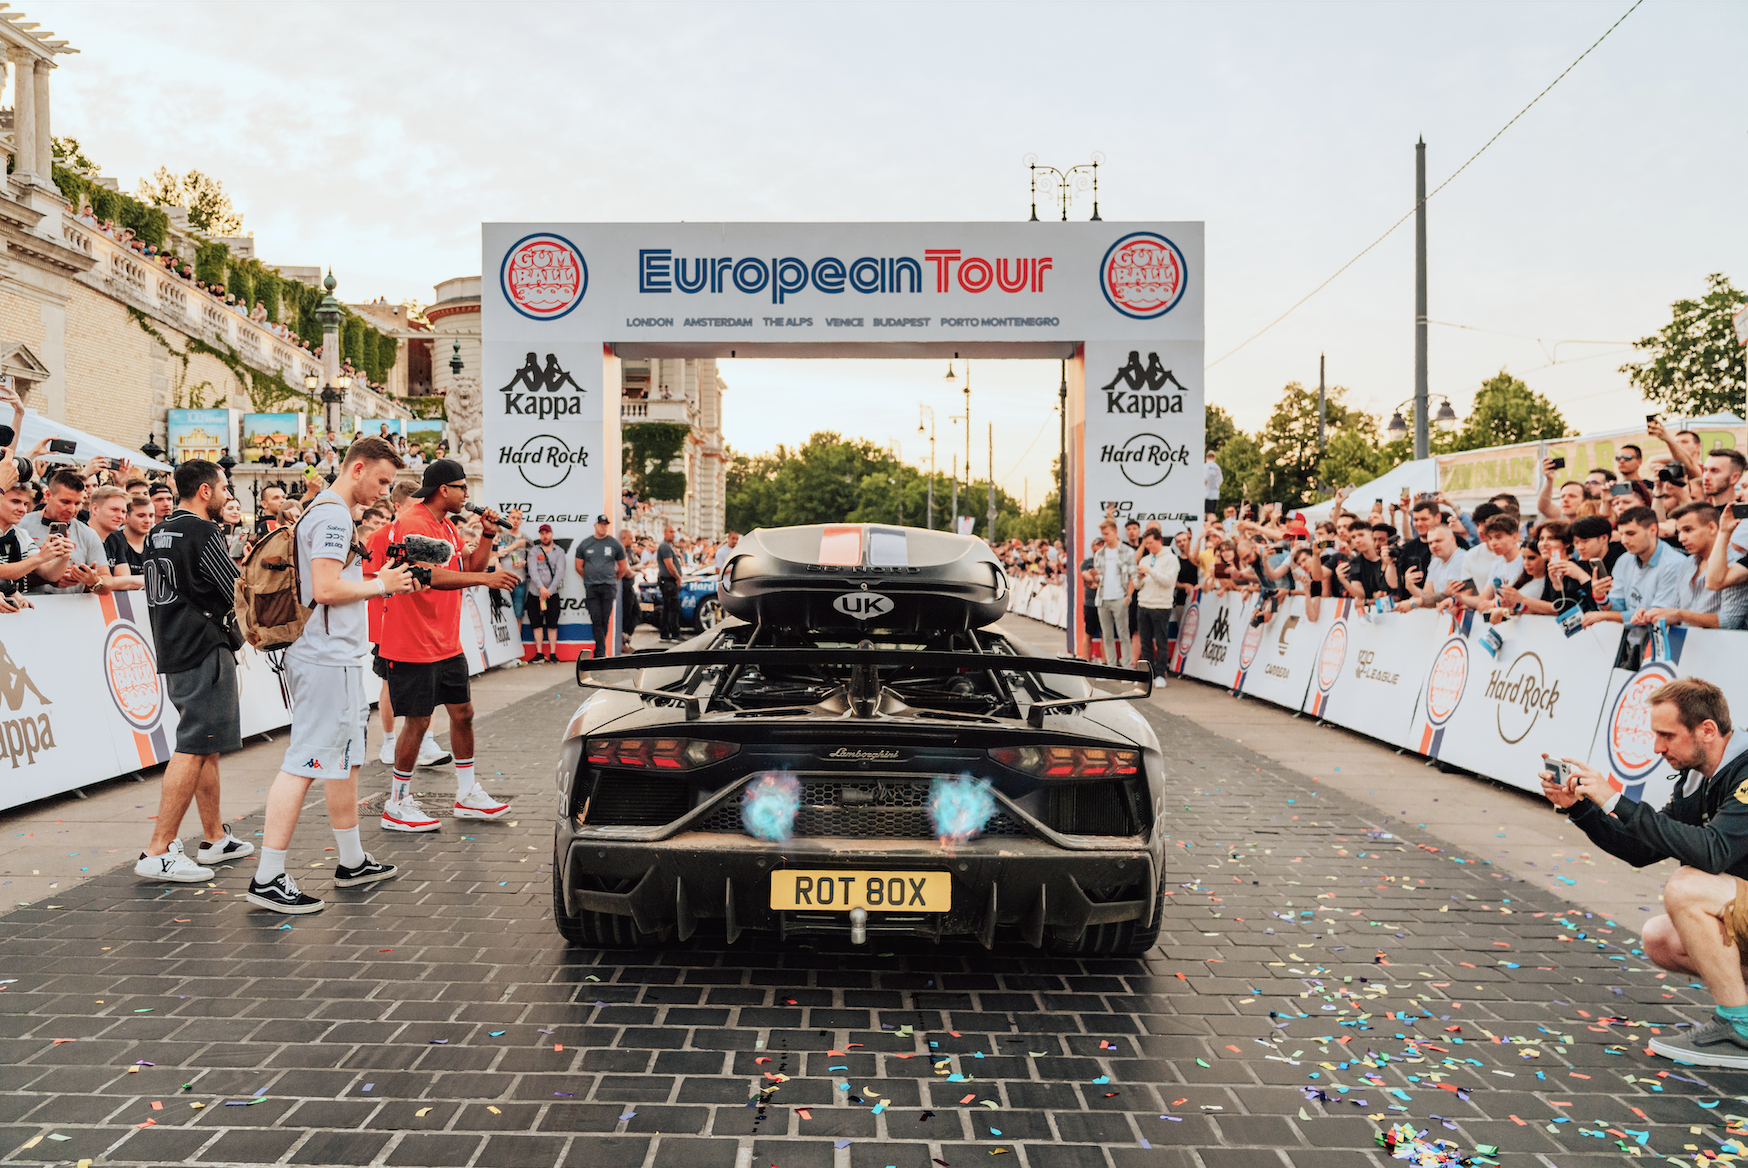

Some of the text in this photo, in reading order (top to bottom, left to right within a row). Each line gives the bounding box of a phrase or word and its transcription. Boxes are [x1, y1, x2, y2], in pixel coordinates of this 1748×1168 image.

[513, 248, 575, 269] GUM
[1113, 247, 1174, 268] GUM
[512, 267, 577, 287] BALL
[1112, 265, 1176, 286] BALL
[515, 285, 575, 304] 3000
[1114, 284, 1175, 303] 3000
[626, 317, 674, 327] LONDON
[683, 317, 753, 327] AMSTERDAM
[763, 317, 814, 327] THE ALPS
[825, 317, 865, 327] VENICE
[873, 317, 931, 327] BUDAPEST
[940, 316, 1060, 327] PORTO MONTENEGRO
[504, 392, 582, 420] Kappa
[1106, 391, 1184, 419] Kappa
[499, 446, 589, 468] Hard Rock
[1100, 444, 1190, 466] Hard Rock
[1442, 456, 1534, 491] LEMONADE
[689, 581, 715, 591] Hard
[842, 597, 885, 614] UK
[109, 643, 151, 669] GUM
[1202, 639, 1228, 667] Kappa
[111, 663, 156, 692] BALL
[1484, 669, 1560, 719] Hard Rock
[828, 747, 900, 761] Lamborghini
[795, 876, 927, 906] ROT 80X
